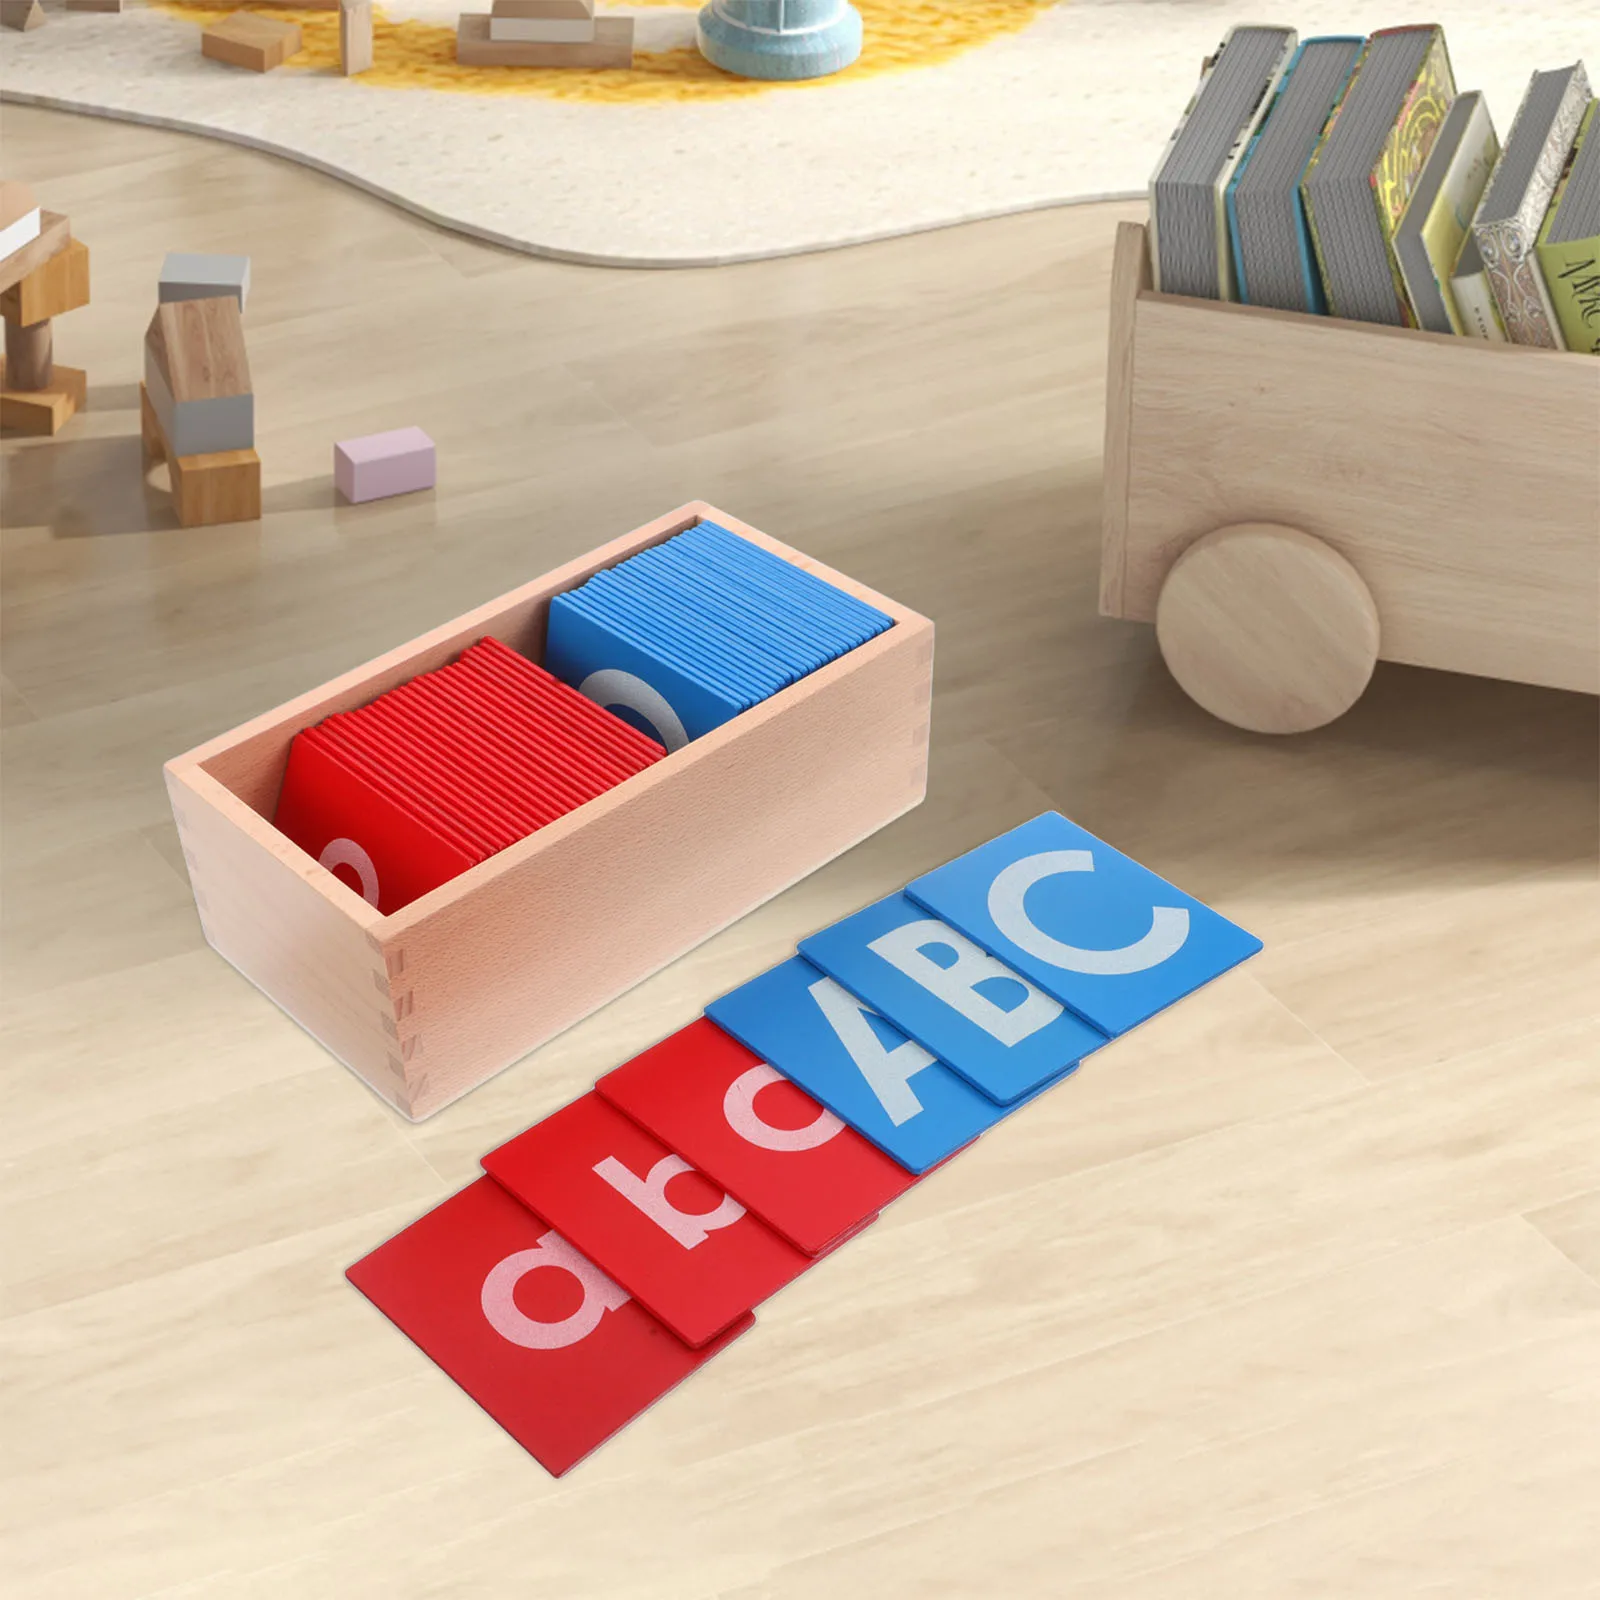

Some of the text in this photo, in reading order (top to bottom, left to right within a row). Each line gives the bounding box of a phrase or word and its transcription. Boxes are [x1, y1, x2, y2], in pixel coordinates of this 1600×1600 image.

[987, 850, 1190, 975] C
[867, 920, 1064, 1047] B
[808, 976, 937, 1127] A
[592, 1155, 746, 1249] b
[481, 1229, 634, 1350] a
